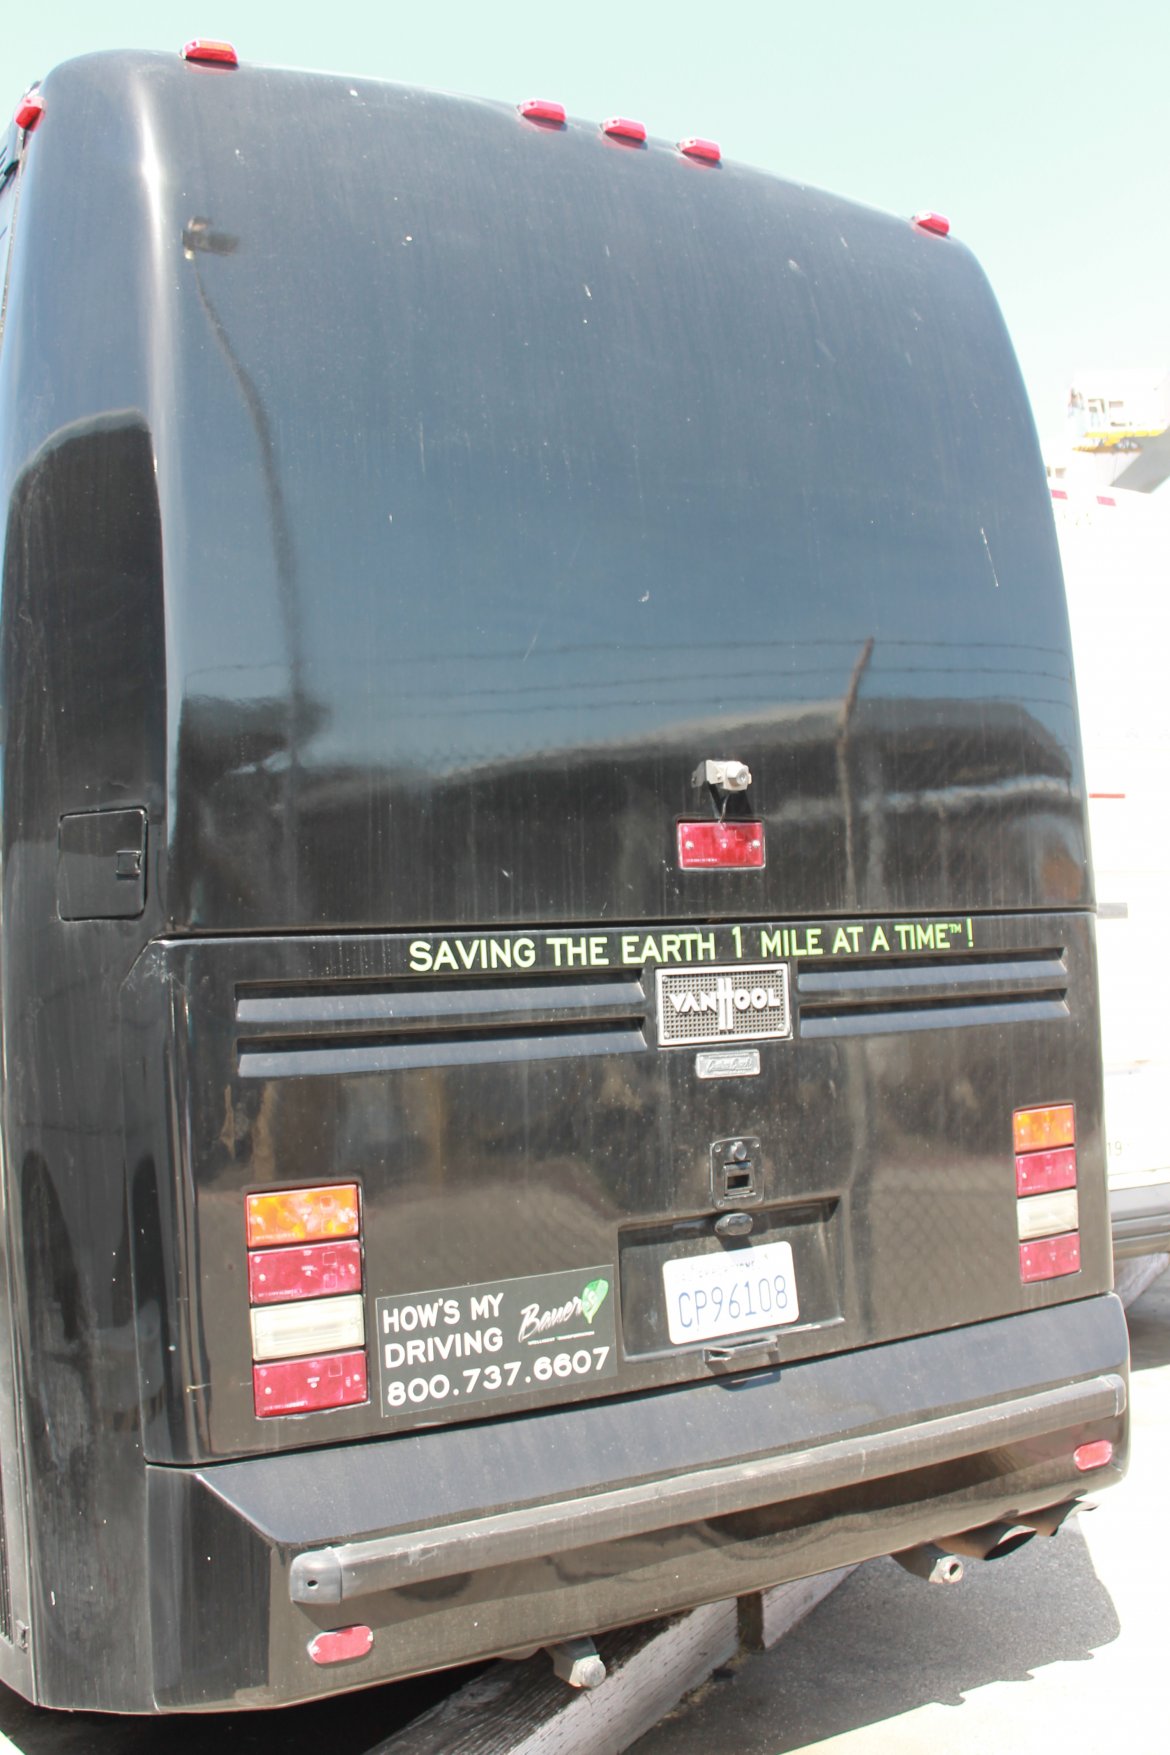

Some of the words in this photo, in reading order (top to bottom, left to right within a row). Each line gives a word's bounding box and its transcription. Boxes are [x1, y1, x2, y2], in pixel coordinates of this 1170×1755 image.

[409, 937, 536, 971] SAVING
[546, 936, 609, 966] THE
[622, 932, 716, 965] EARTH
[731, 926, 743, 959] 1
[760, 928, 824, 958] MILE
[832, 926, 864, 954] AT
[870, 925, 891, 952] A
[382, 1298, 461, 1334] HOW'S
[470, 1292, 504, 1321] MY
[678, 1275, 788, 1329] CP96108
[384, 1327, 504, 1369] DRIVING
[387, 1346, 610, 1407] 800.737.6607
